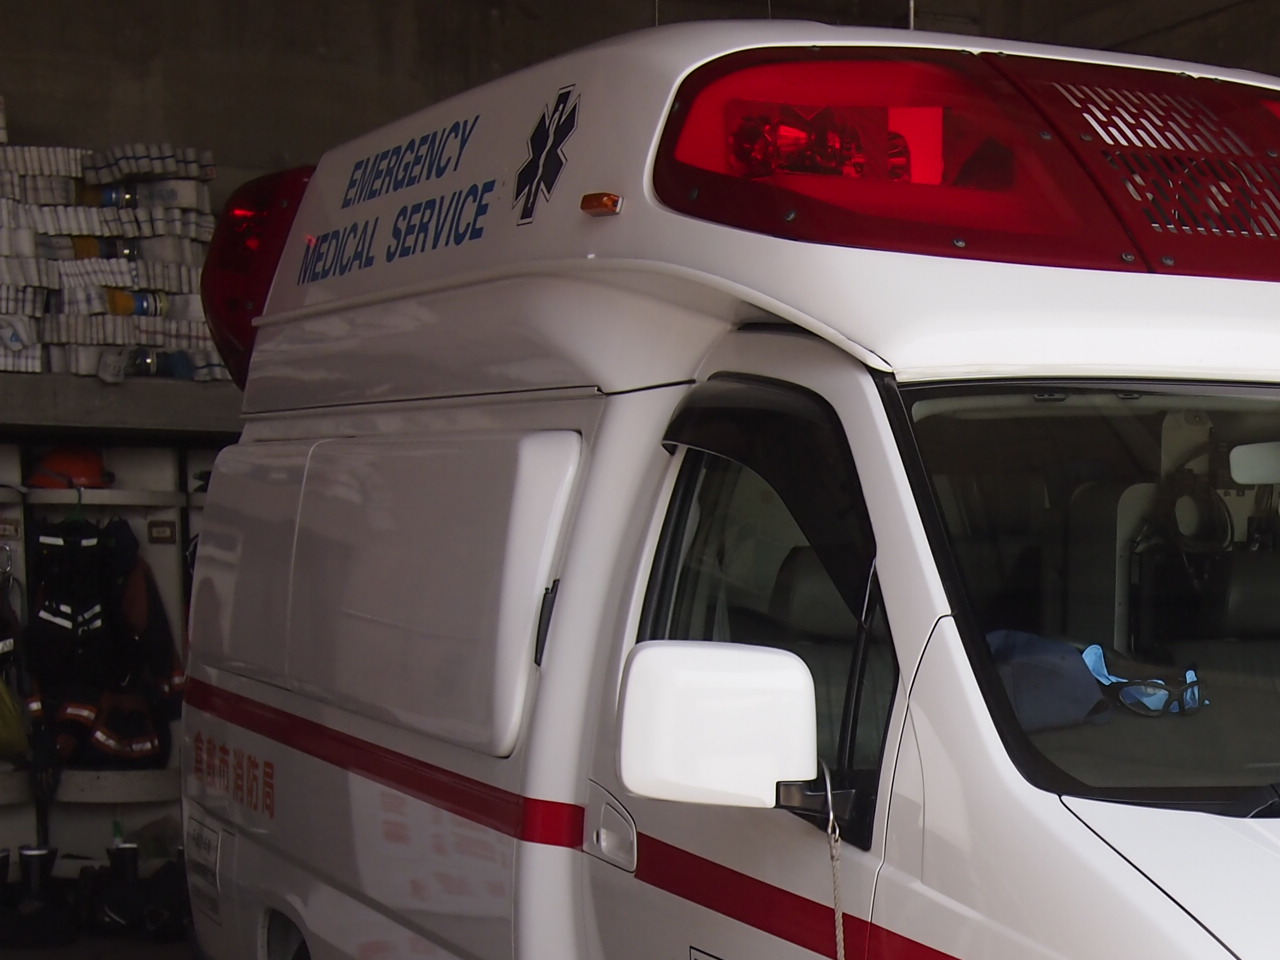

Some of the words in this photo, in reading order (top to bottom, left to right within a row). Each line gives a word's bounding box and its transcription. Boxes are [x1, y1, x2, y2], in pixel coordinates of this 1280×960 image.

[341, 114, 480, 209] EMERGENCY
[297, 217, 379, 285] MEDICAL
[386, 179, 496, 263] SERVICE
